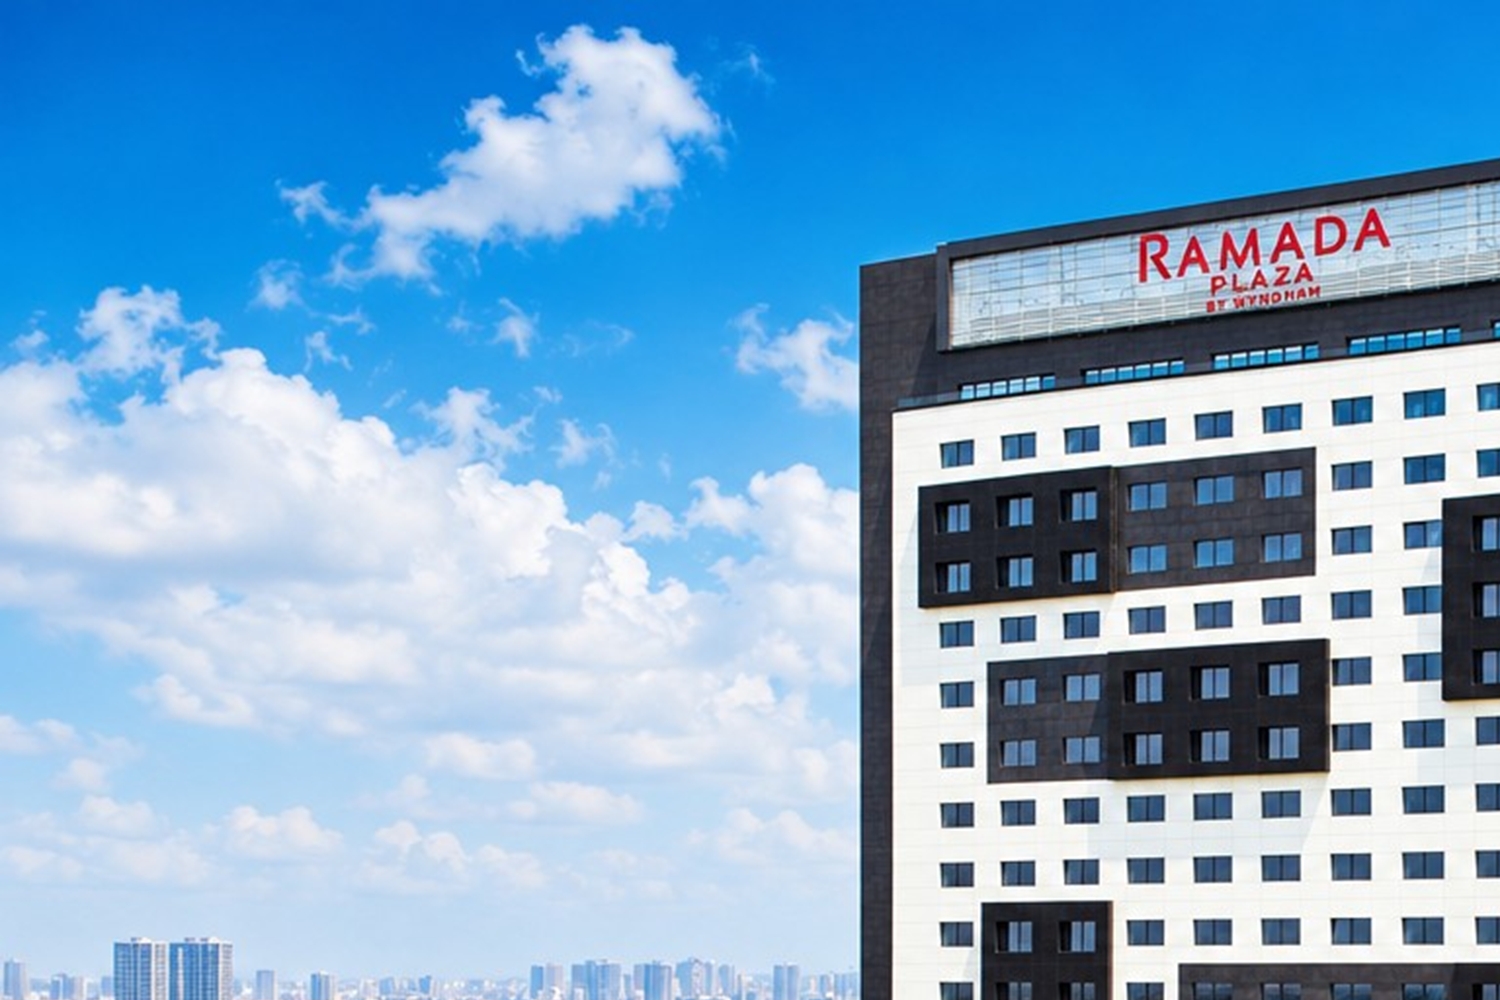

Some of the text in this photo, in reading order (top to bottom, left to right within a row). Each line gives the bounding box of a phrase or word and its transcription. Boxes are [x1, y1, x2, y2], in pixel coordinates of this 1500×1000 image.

[1139, 207, 1391, 283] RAMADA
[1210, 262, 1314, 296] PLAZA
[1206, 285, 1321, 313] BY WYNDHAM
